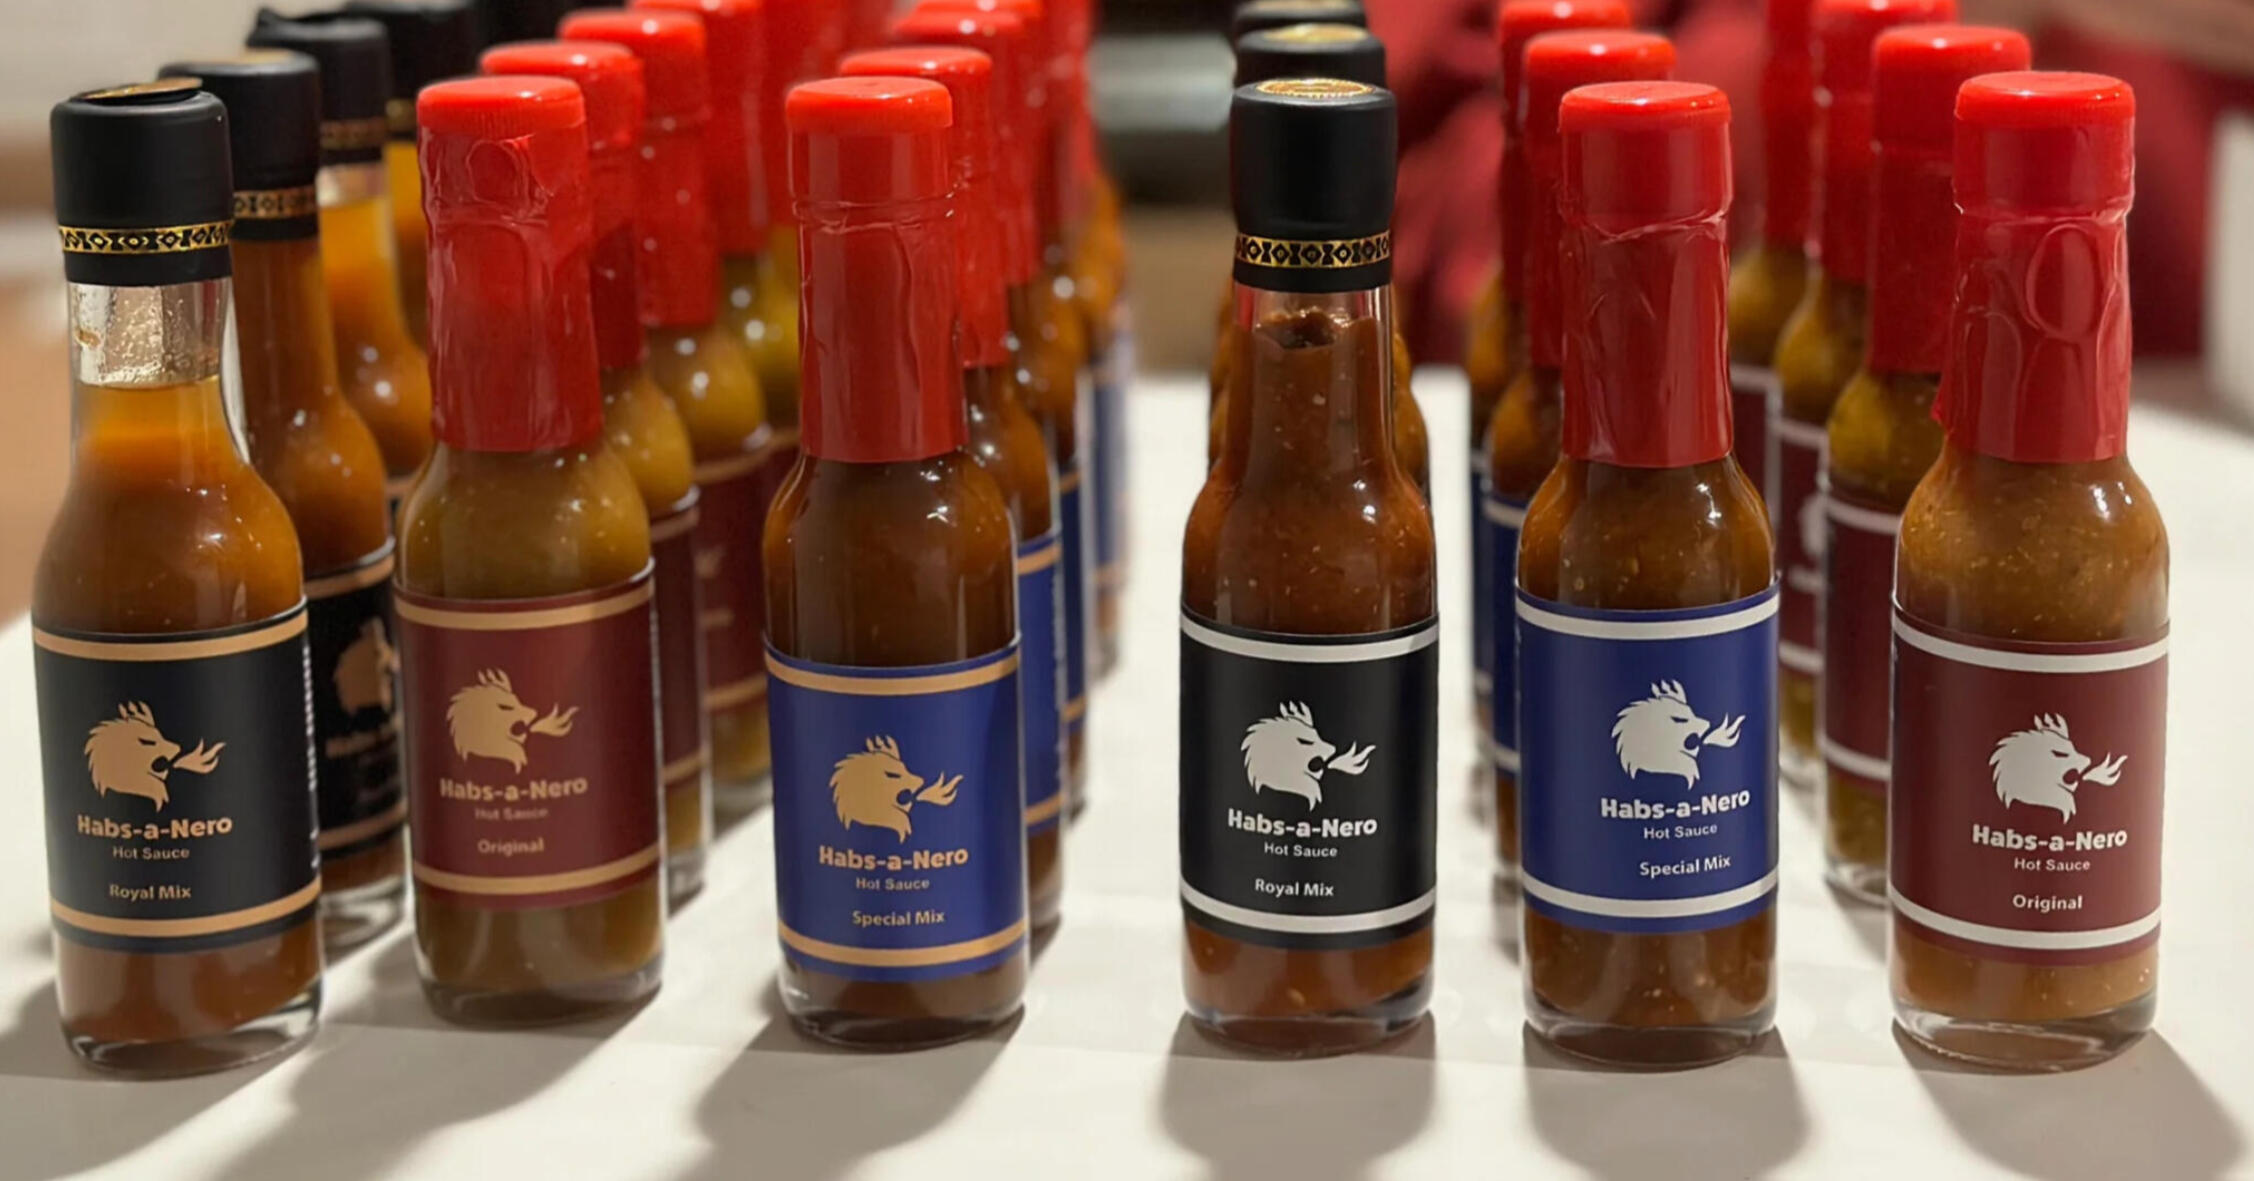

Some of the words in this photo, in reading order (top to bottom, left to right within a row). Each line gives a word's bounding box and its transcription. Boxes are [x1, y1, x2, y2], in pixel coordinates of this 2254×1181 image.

[440, 778, 588, 800] Habs-a-Nero
[1600, 790, 1750, 819] Habs-a-Nero
[77, 814, 233, 840] Habs-a-Nero
[1228, 808, 1378, 837] Habs-a-Nero
[1643, 827, 1670, 839] Hot
[1674, 824, 1718, 838] Sauce
[1972, 824, 2128, 851] Habs-a-Nero
[112, 846, 138, 859] Hot
[142, 847, 190, 860] Sauce
[477, 838, 545, 857] Original
[1264, 842, 1289, 856] Hot
[1293, 844, 1338, 857] Sauce
[819, 845, 969, 870] Habs-a-Nero
[1639, 858, 1700, 878] Special
[1703, 854, 1731, 871] Mix
[2014, 857, 2041, 870] Hot
[2046, 859, 2091, 871] Sauce
[109, 884, 154, 902] Royal
[158, 885, 192, 899] Mix
[855, 877, 880, 890] Hot
[885, 878, 930, 890] Sauce
[1255, 878, 1300, 898] Royal
[1303, 882, 1334, 897] Mix
[2012, 894, 2083, 913] Original
[852, 910, 911, 928] Special
[915, 910, 945, 925] Mix
